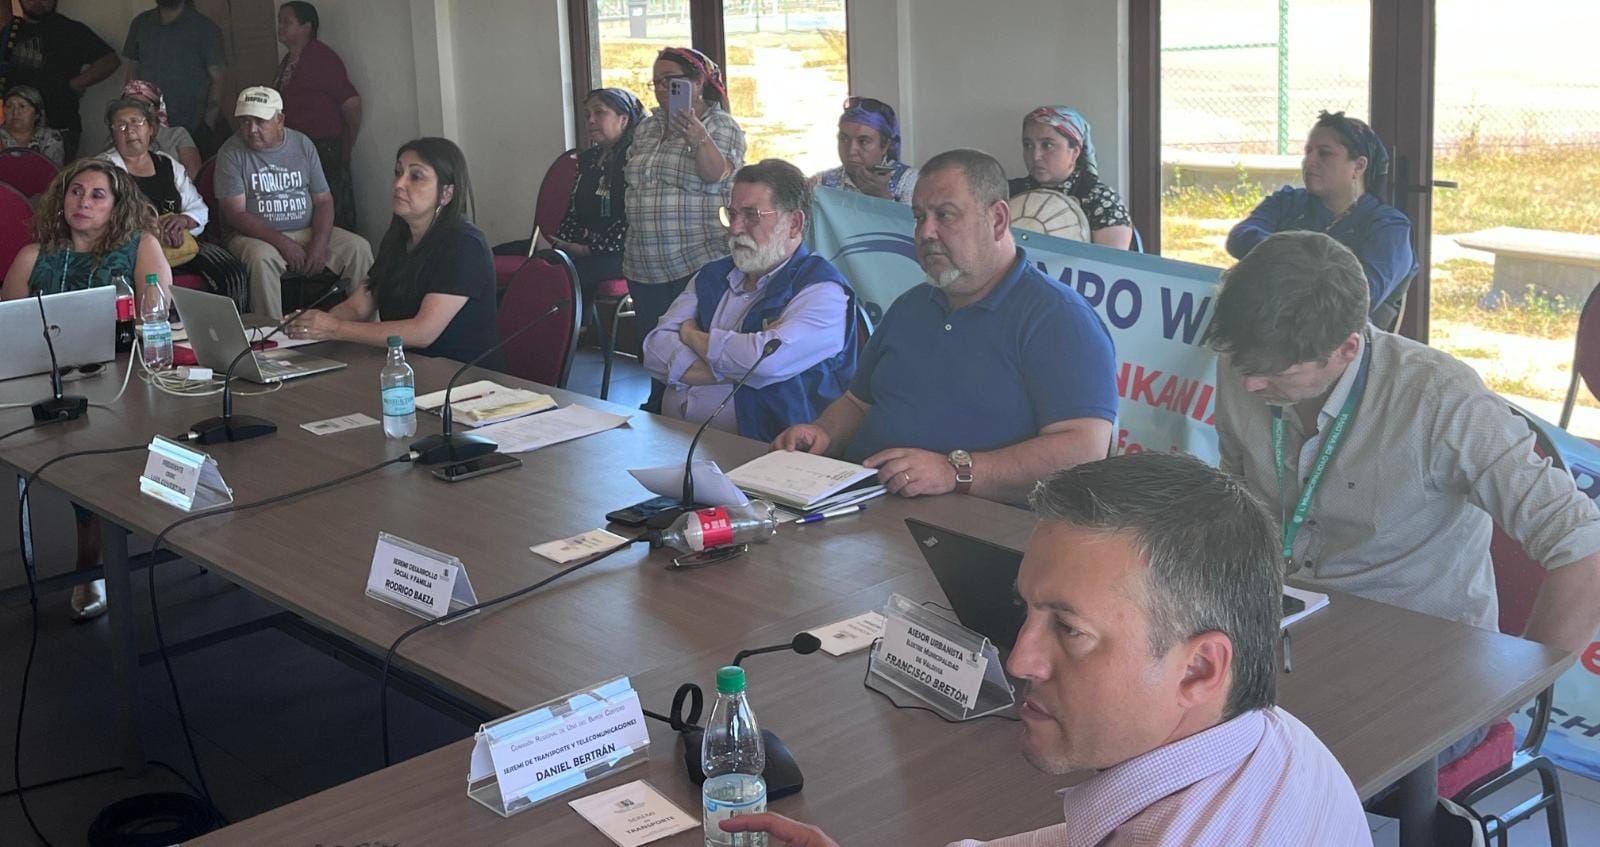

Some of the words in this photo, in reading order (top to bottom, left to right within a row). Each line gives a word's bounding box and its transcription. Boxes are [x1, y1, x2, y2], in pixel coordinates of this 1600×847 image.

[251, 171, 302, 192] FIORUCCI
[258, 197, 307, 213] COMPANY
[1160, 286, 1215, 347] W
[1116, 362, 1216, 426] NKANI
[1329, 413, 1349, 444] VALDIVIA
[1325, 445, 1334, 456] DE
[394, 568, 409, 580] SOCIAL
[413, 576, 432, 589] FAMILIA
[408, 564, 438, 580] DESARROLLO
[385, 579, 413, 597] RODRIGO
[413, 590, 434, 606] BAEZA
[907, 627, 930, 644] ASESOR
[930, 638, 963, 661] URBANISTA
[885, 653, 932, 683] FRANCISCO
[503, 763, 524, 775] SEREMI
[525, 758, 533, 767] DE
[533, 745, 570, 762] TRANSPORTE
[536, 762, 572, 782] DANIEL
[573, 743, 616, 767] BERTRÁN
[625, 816, 675, 834] TRANSPORTE
